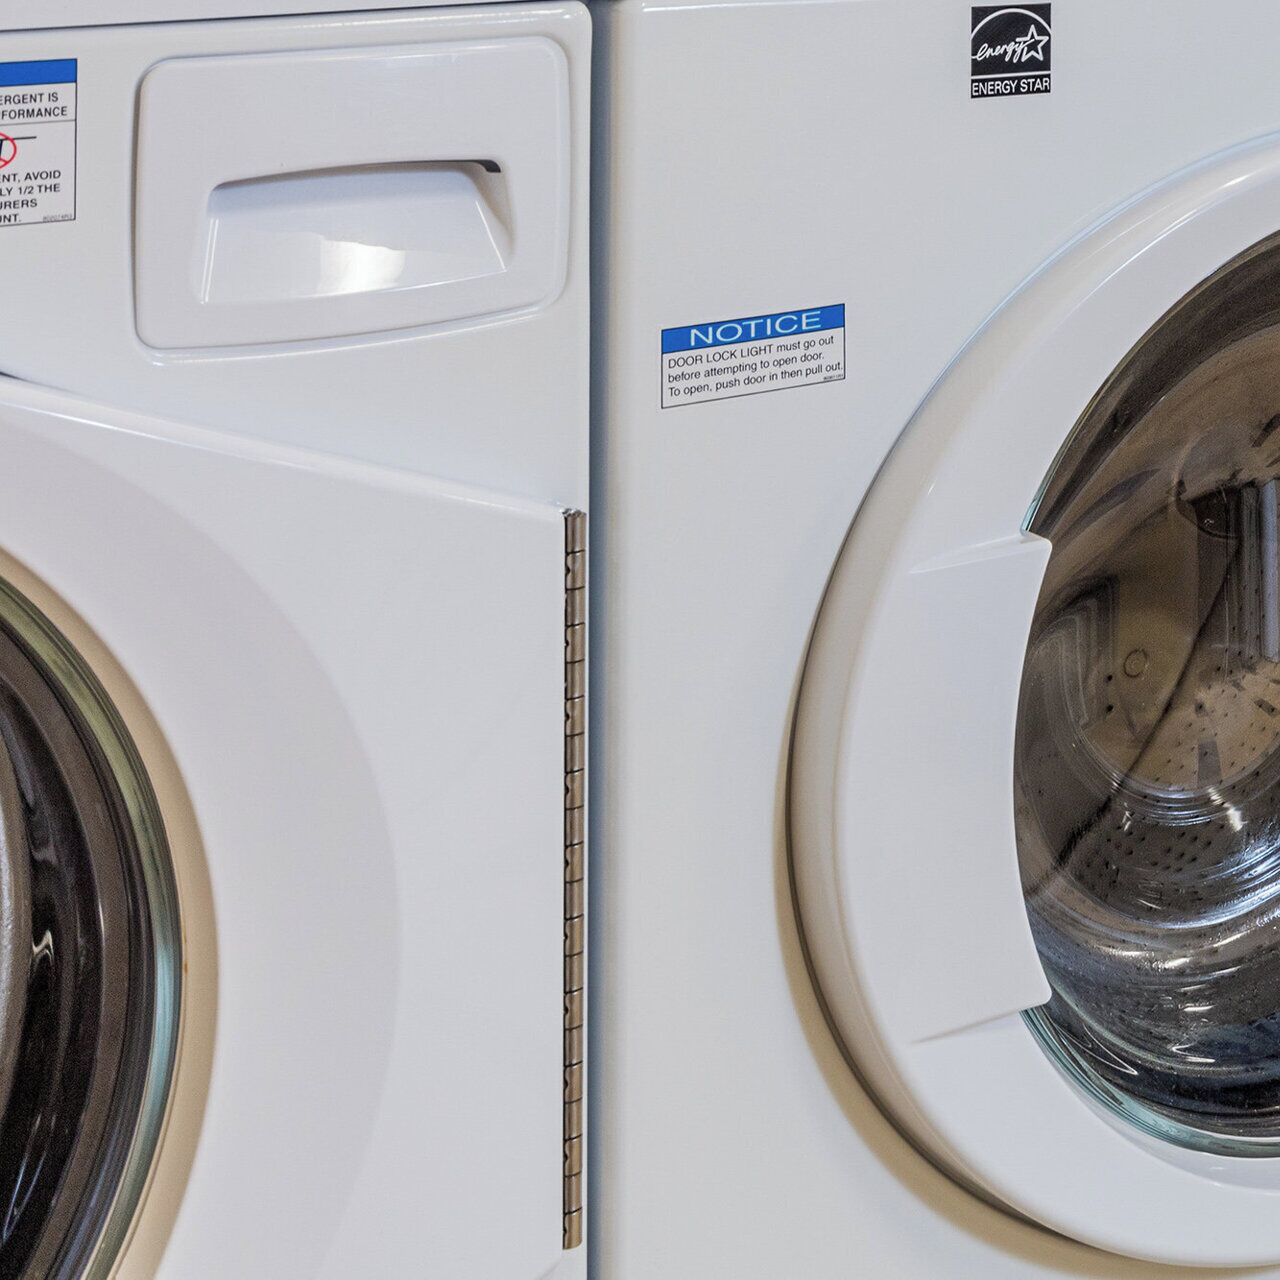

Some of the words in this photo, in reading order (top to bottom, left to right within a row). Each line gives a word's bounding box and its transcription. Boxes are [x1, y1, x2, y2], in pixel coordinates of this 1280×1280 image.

[972, 80, 1018, 96] ENERGY
[1020, 77, 1050, 92] STAR
[48, 92, 59, 103] IS
[0, 173, 20, 184] NT,
[24, 170, 61, 181] AVOID
[18, 185, 34, 196] 1/2
[37, 183, 61, 193] THE
[0, 213, 21, 223] NT.
[690, 310, 821, 347] NOTICE
[668, 355, 703, 369] DOOR
[706, 349, 737, 363] LOCK
[740, 344, 773, 358] LIGHT
[776, 341, 801, 353] must
[803, 339, 816, 352] go
[818, 335, 835, 346] out
[668, 370, 701, 383] before
[704, 361, 758, 378] attempting
[760, 359, 770, 370] to
[772, 356, 798, 369] open
[800, 351, 825, 363] door.
[668, 387, 681, 398] To
[683, 383, 712, 397] open,
[715, 377, 741, 392] push
[743, 373, 766, 387] door
[768, 371, 778, 382] in
[780, 368, 803, 380] then
[805, 364, 823, 379] pull
[825, 362, 843, 372] out.
